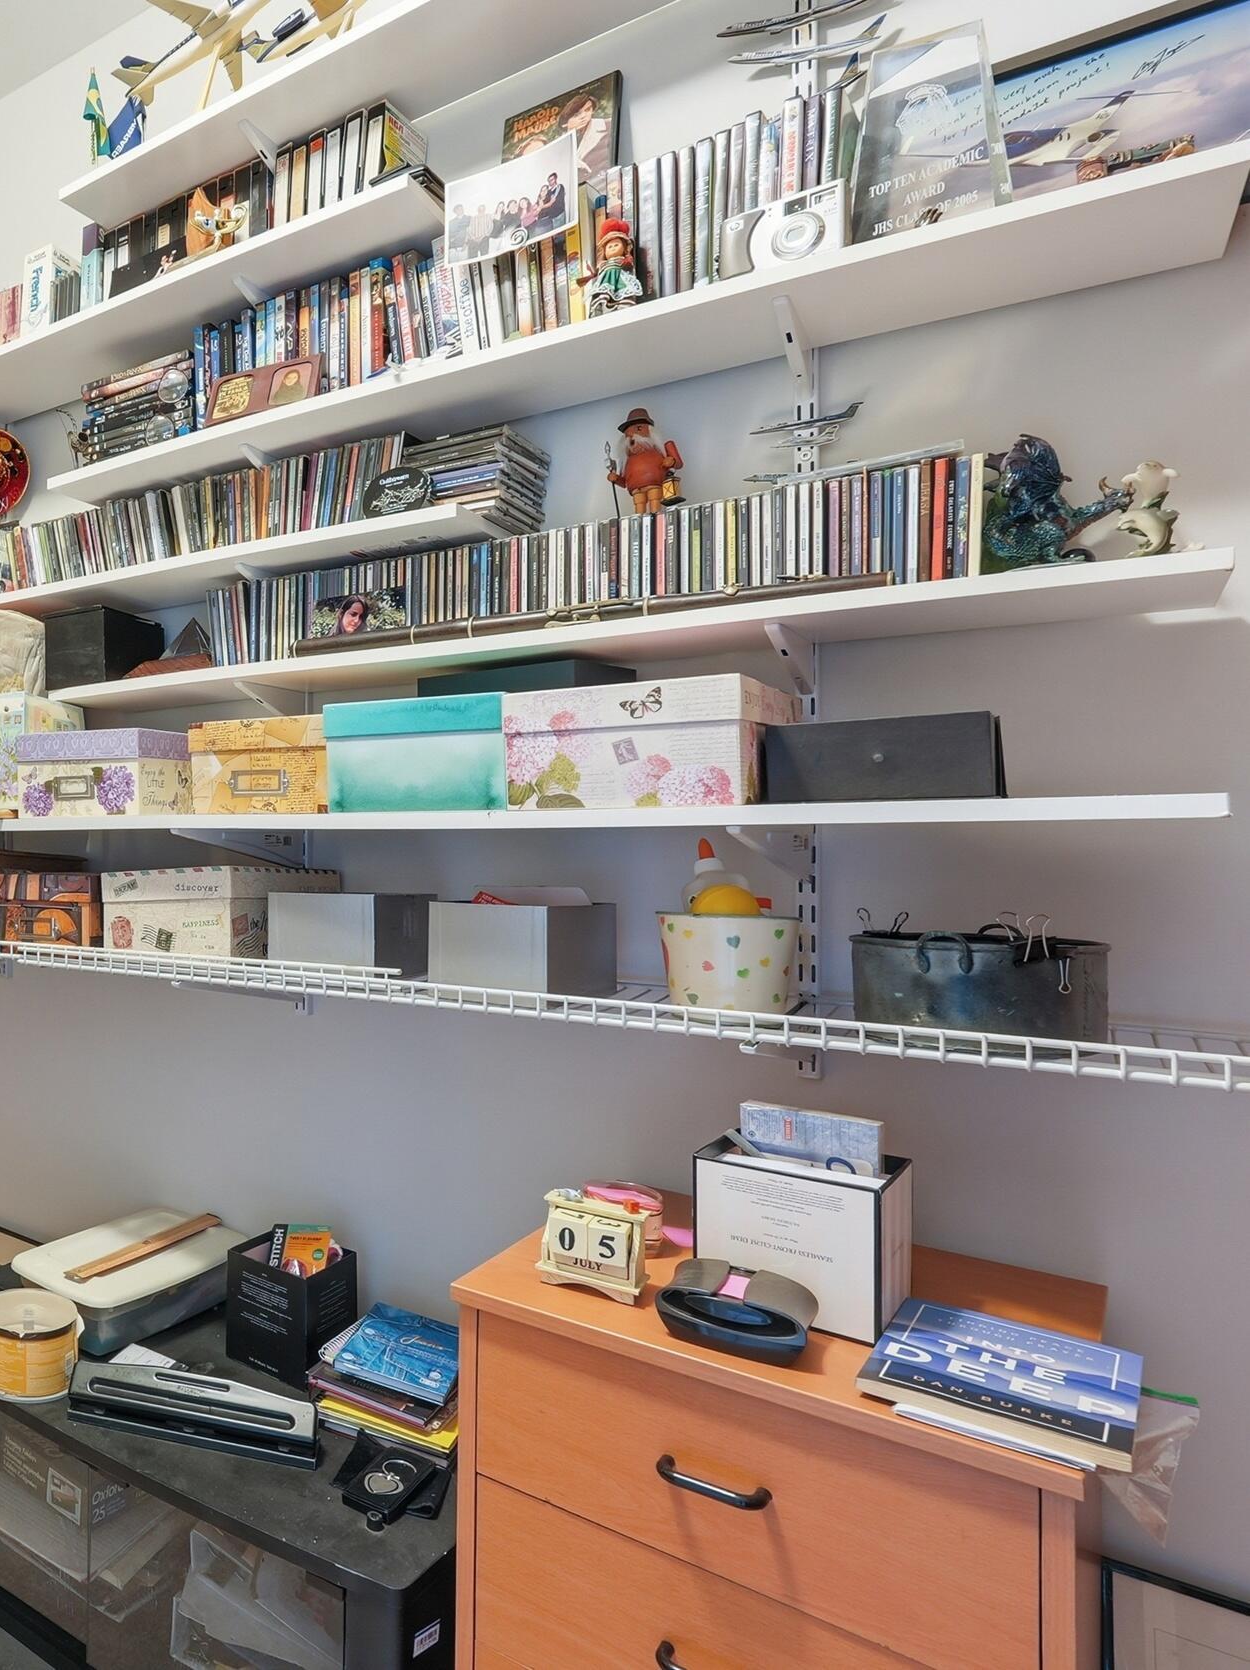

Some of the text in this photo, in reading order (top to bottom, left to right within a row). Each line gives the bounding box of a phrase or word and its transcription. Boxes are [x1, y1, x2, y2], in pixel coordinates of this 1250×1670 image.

[513, 105, 559, 132] HAROLD
[514, 116, 558, 143] MAUDE
[868, 146, 984, 199] TOP TEN ACADEMIC
[903, 182, 946, 207] AWARD
[872, 218, 894, 237] JHS
[953, 190, 980, 210] 2005
[30, 265, 44, 313] French
[146, 780, 166, 788] LITTLE
[174, 883, 221, 893] discover
[559, 1227, 615, 1259] 0 5
[573, 1258, 603, 1272] JULY
[938, 1338, 1068, 1386] THE
[965, 1336, 1057, 1364] INTO
[883, 1342, 1126, 1417] DEEP
[913, 1375, 1073, 1427] DAN BURKE
[92, 1508, 106, 1522] 25
